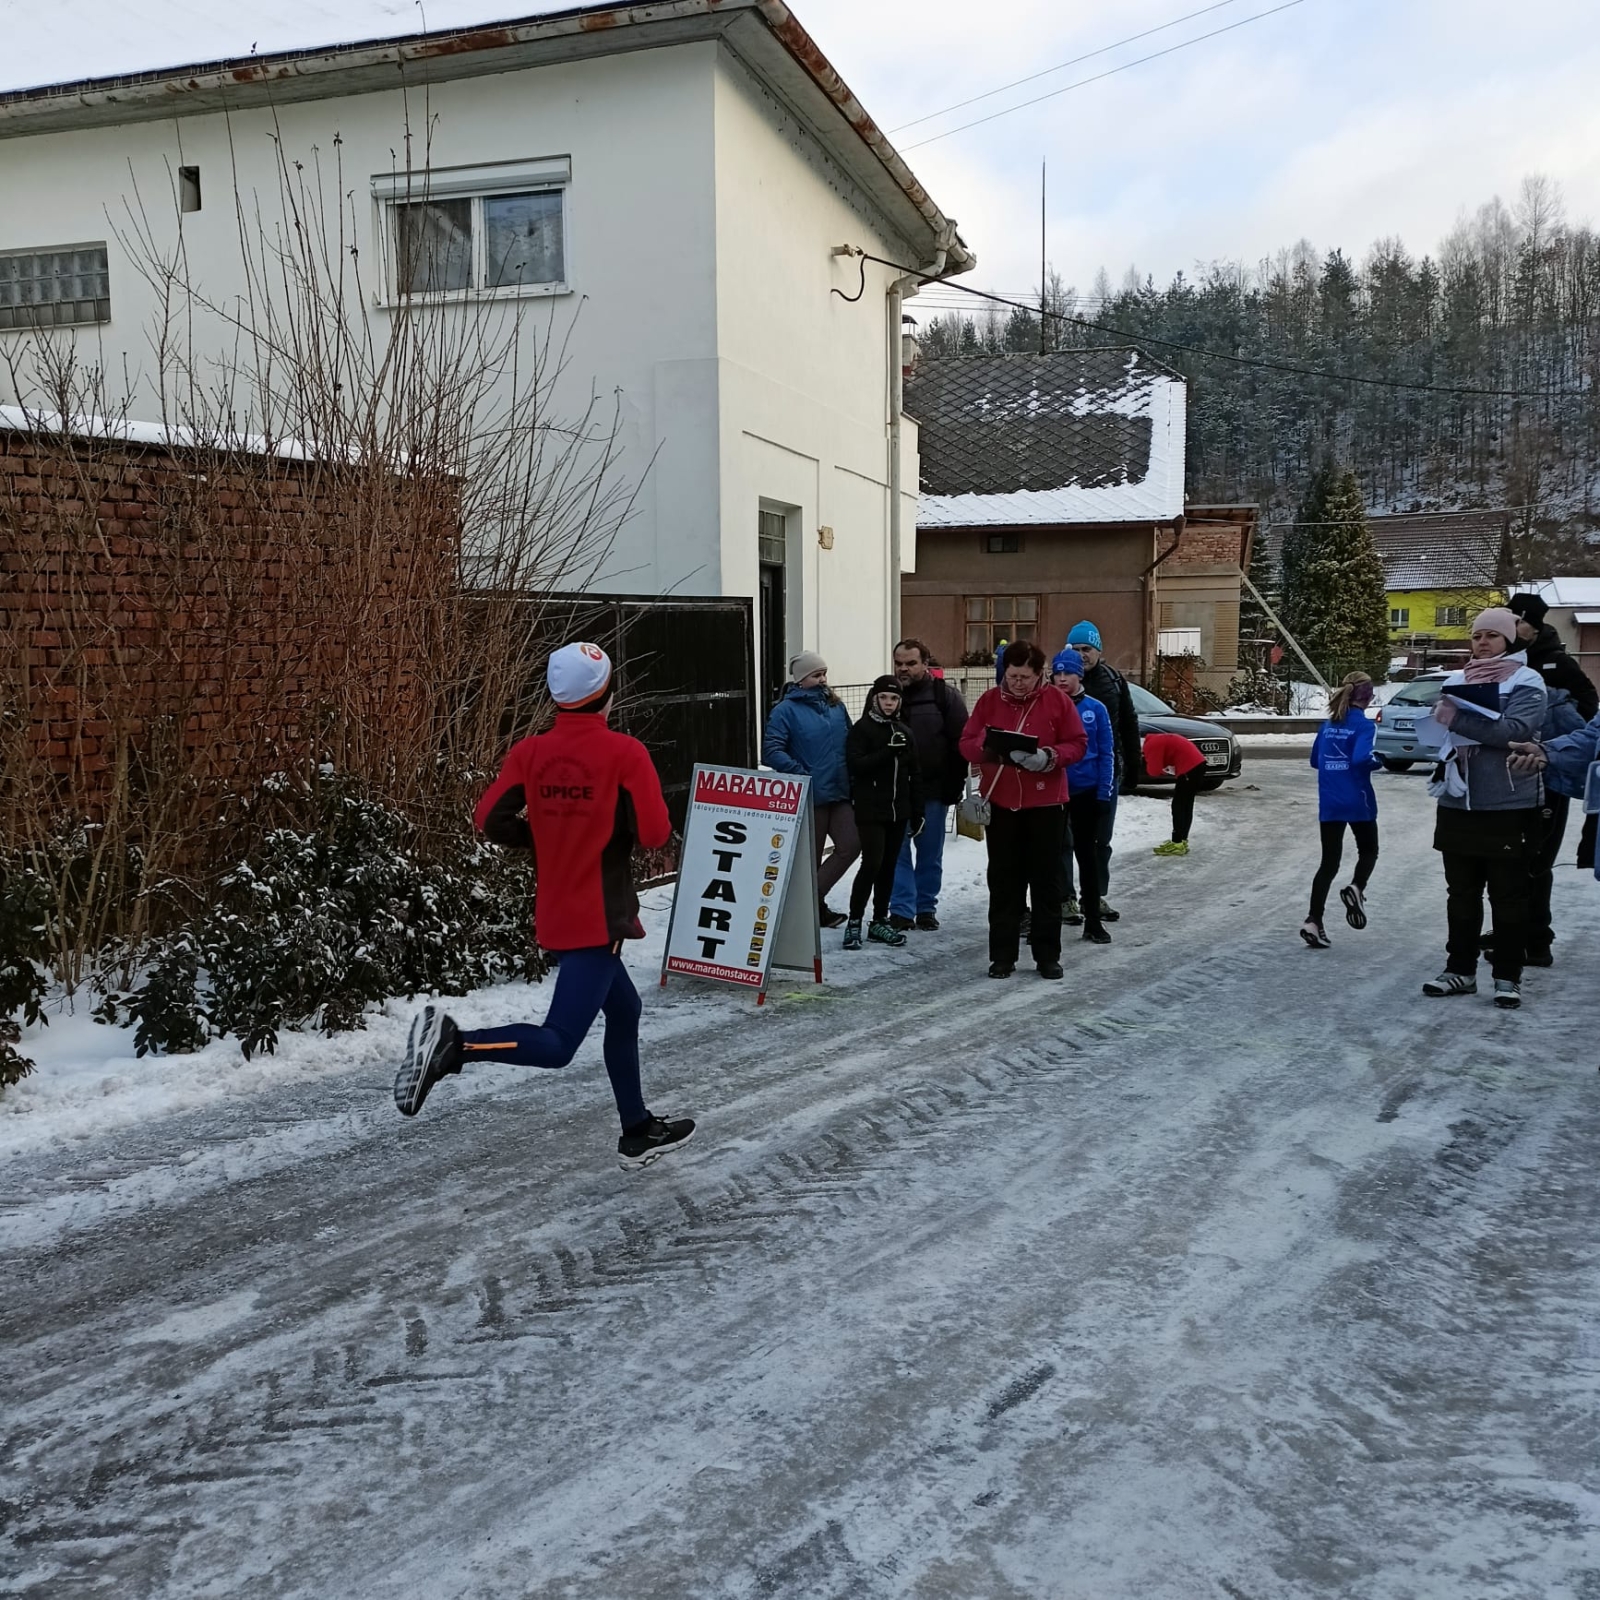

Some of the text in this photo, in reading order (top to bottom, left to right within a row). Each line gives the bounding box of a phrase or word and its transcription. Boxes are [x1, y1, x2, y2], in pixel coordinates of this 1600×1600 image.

[697, 770, 803, 800] MARATON
[743, 810, 772, 820] jednota
[768, 800, 795, 811] stav
[696, 821, 748, 960] START
[671, 959, 760, 983] www.maratonstav.cz
